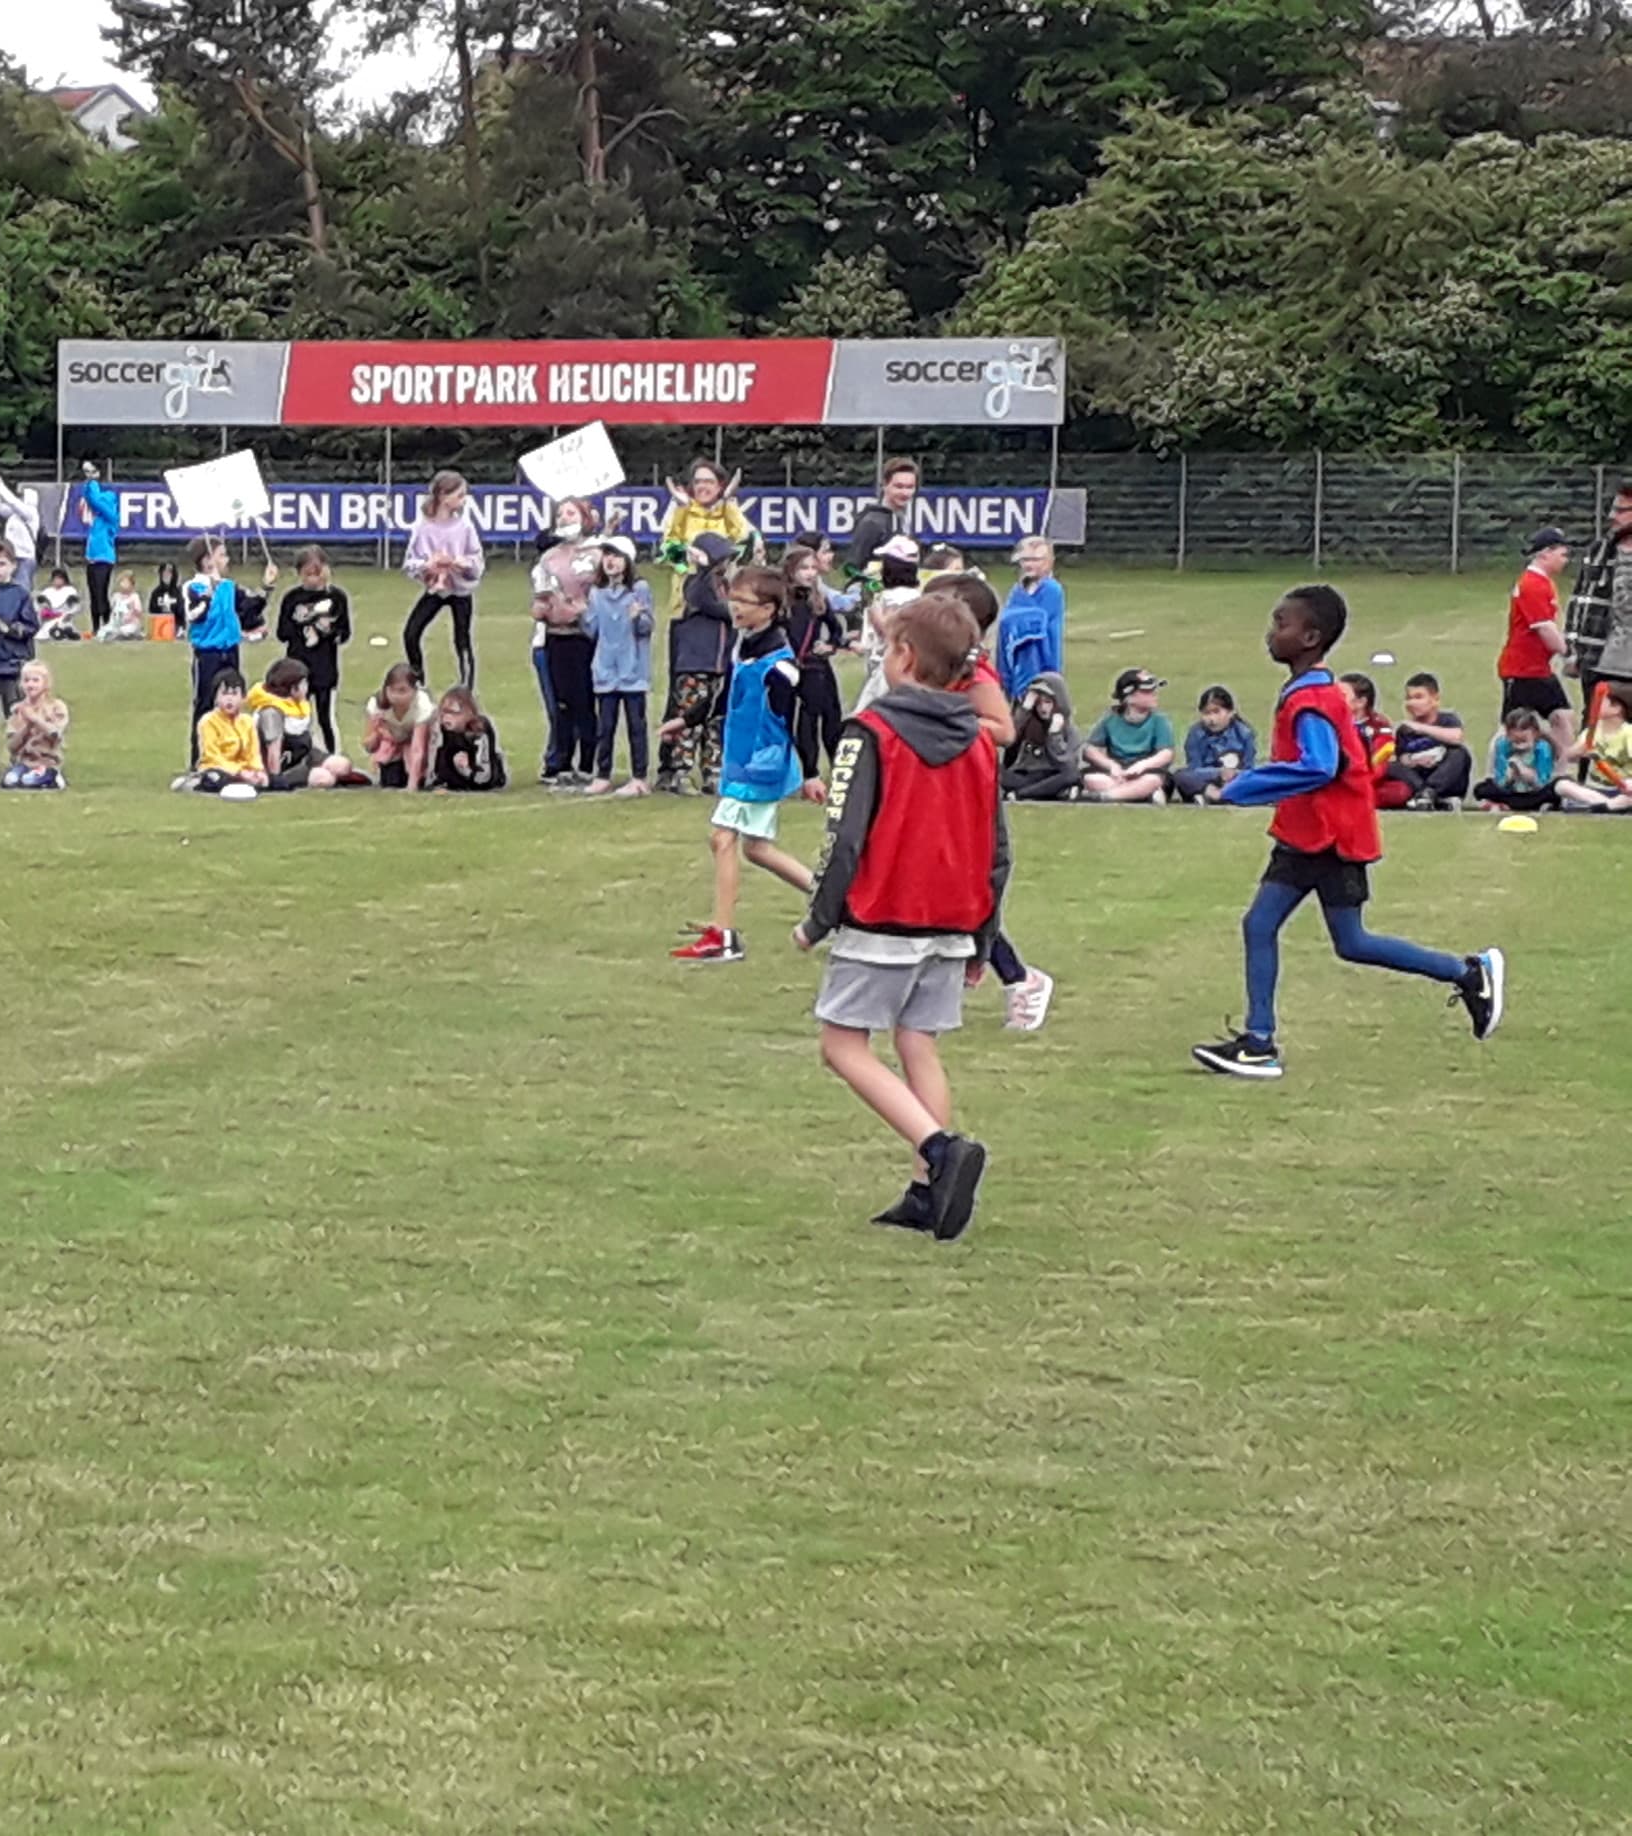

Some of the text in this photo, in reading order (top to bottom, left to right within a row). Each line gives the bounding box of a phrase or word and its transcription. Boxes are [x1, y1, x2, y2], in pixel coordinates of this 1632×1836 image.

[350, 362, 757, 405] SPORTPARK HEUCHELHOF
[119, 491, 552, 532] FREN BRUNEN
[827, 496, 1035, 534] BNNEN
